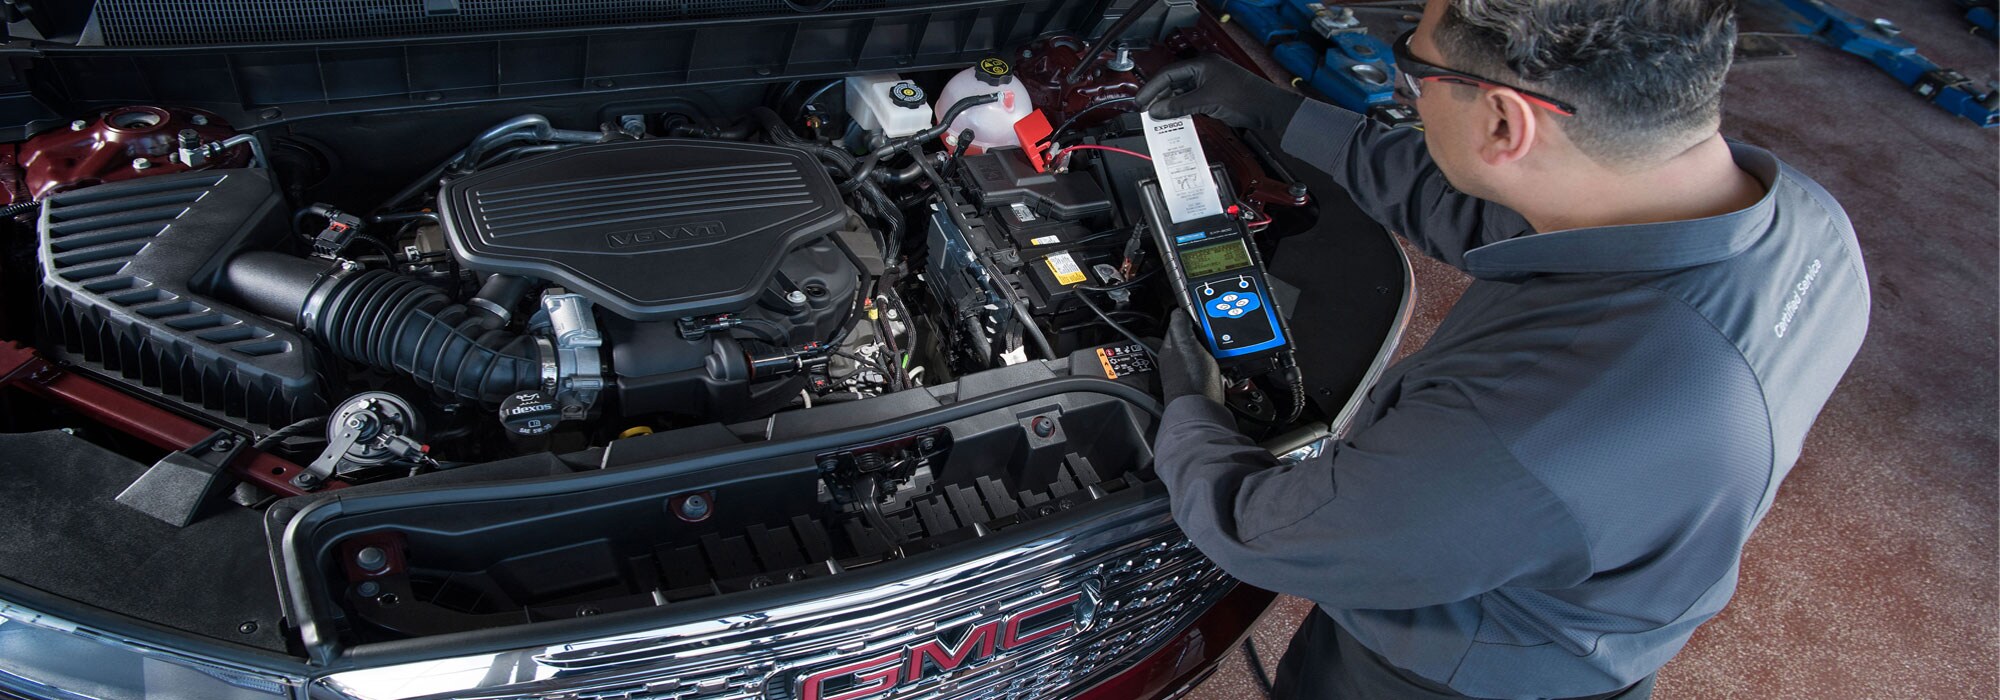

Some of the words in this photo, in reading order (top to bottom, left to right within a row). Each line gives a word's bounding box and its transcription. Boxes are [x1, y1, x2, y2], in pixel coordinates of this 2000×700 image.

[1774, 290, 1802, 338] Certified
[1796, 259, 1821, 296] Service
[512, 403, 552, 415] dexos
[797, 592, 1083, 700] GMC
